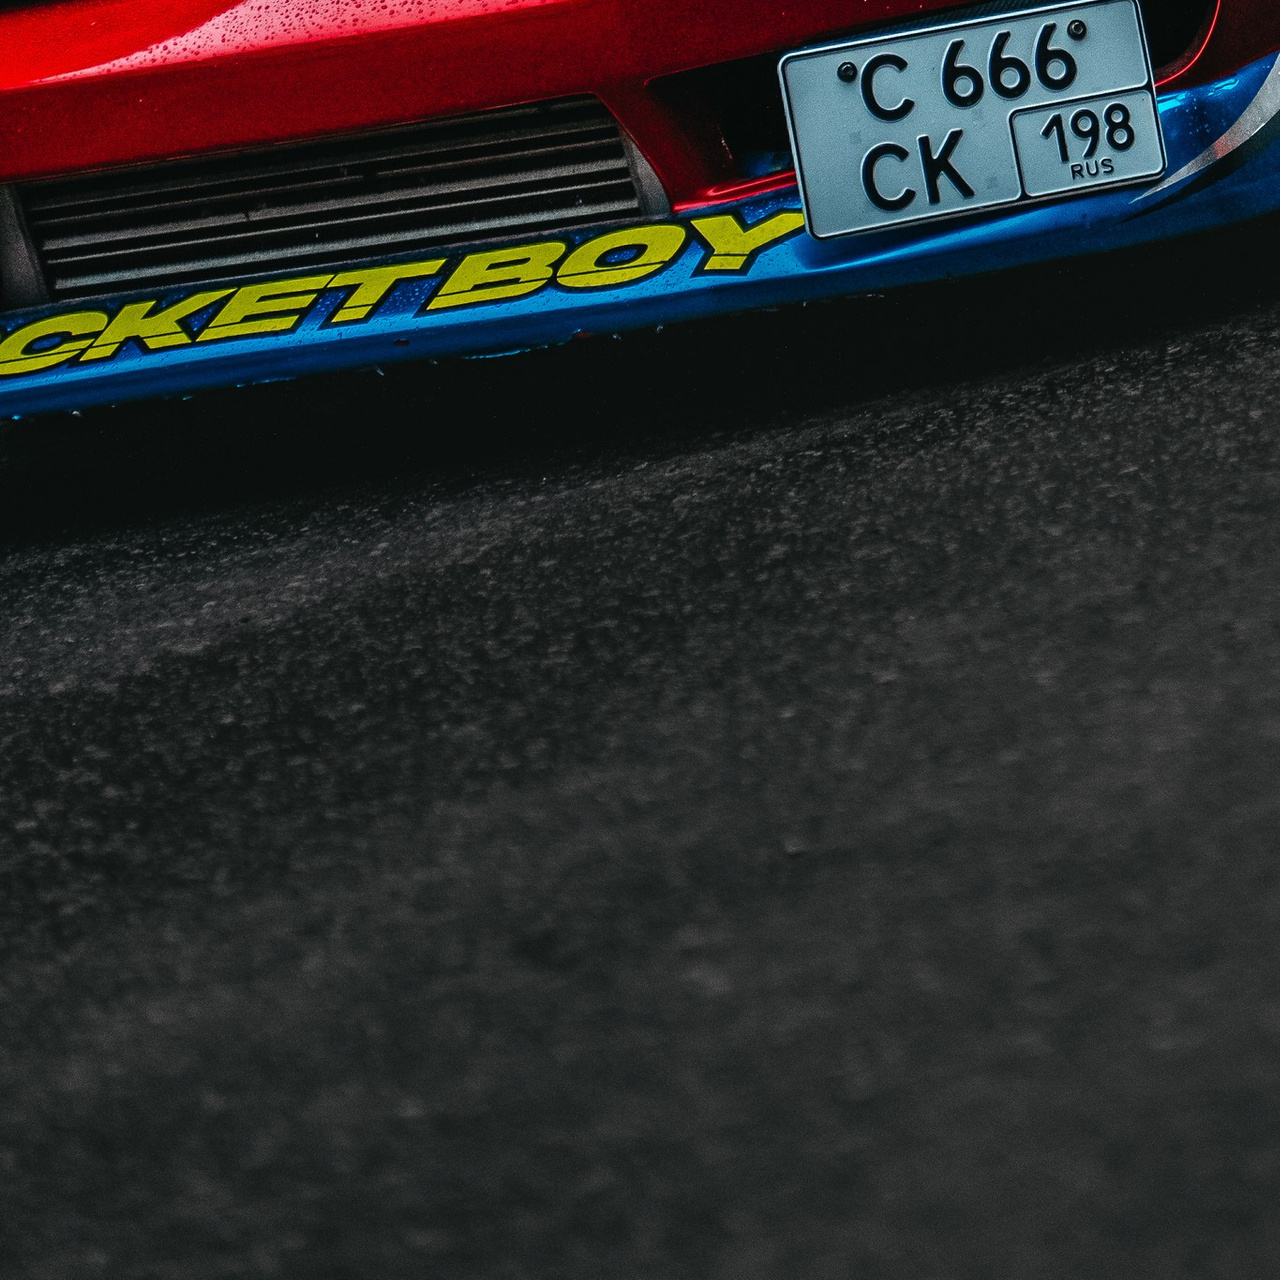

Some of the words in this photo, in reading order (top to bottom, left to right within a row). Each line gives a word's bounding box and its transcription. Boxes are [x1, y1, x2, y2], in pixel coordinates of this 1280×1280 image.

[941, 22, 1077, 108] 666
[1040, 103, 1135, 163] 198
[1071, 157, 1115, 180] RUS
[861, 129, 975, 211] CK
